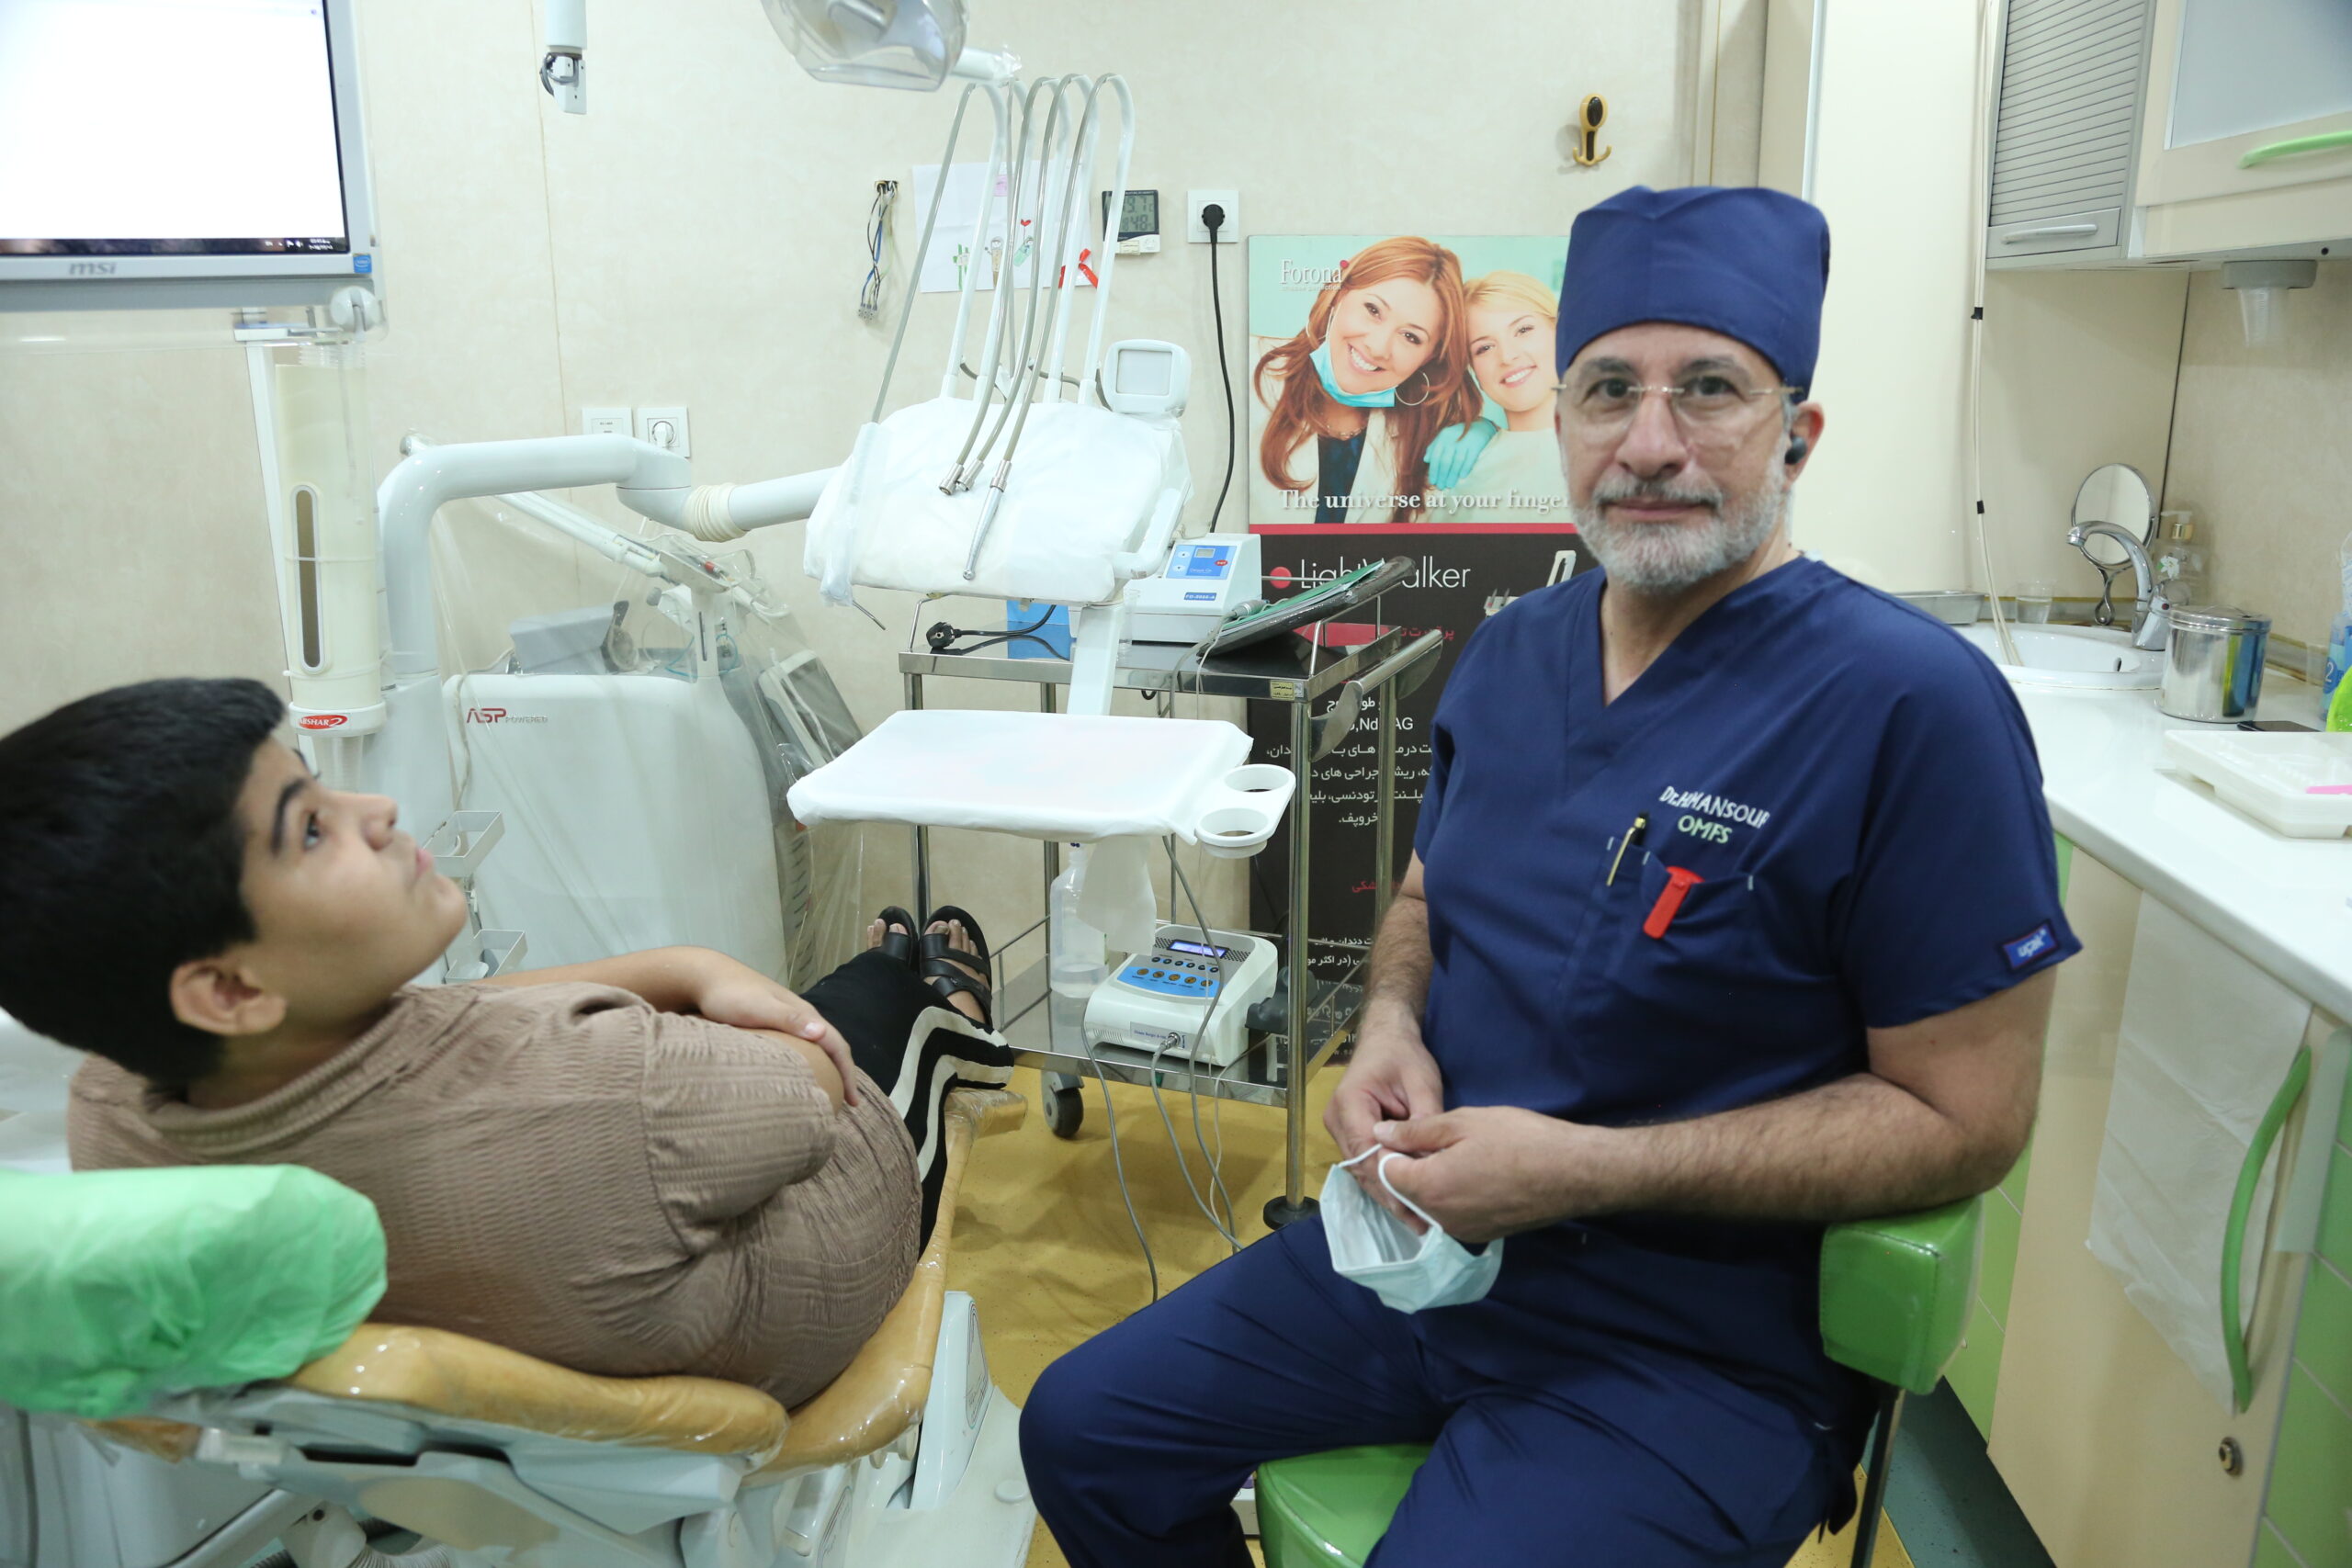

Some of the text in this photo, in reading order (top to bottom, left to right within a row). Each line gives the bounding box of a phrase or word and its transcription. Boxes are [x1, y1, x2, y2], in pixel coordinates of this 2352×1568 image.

[69, 262, 118, 275] msi
[1279, 258, 1342, 285] Fotona
[1278, 489, 1320, 509] The
[1324, 491, 1420, 509] universe
[1425, 491, 1447, 508] at
[1449, 495, 1501, 514] your
[2324, 661, 2335, 682] 2
[466, 708, 548, 724] ASP POWERED
[1321, 767, 1342, 781] های
[1344, 766, 1379, 780] جراحی
[1678, 815, 1733, 844] OMFS
